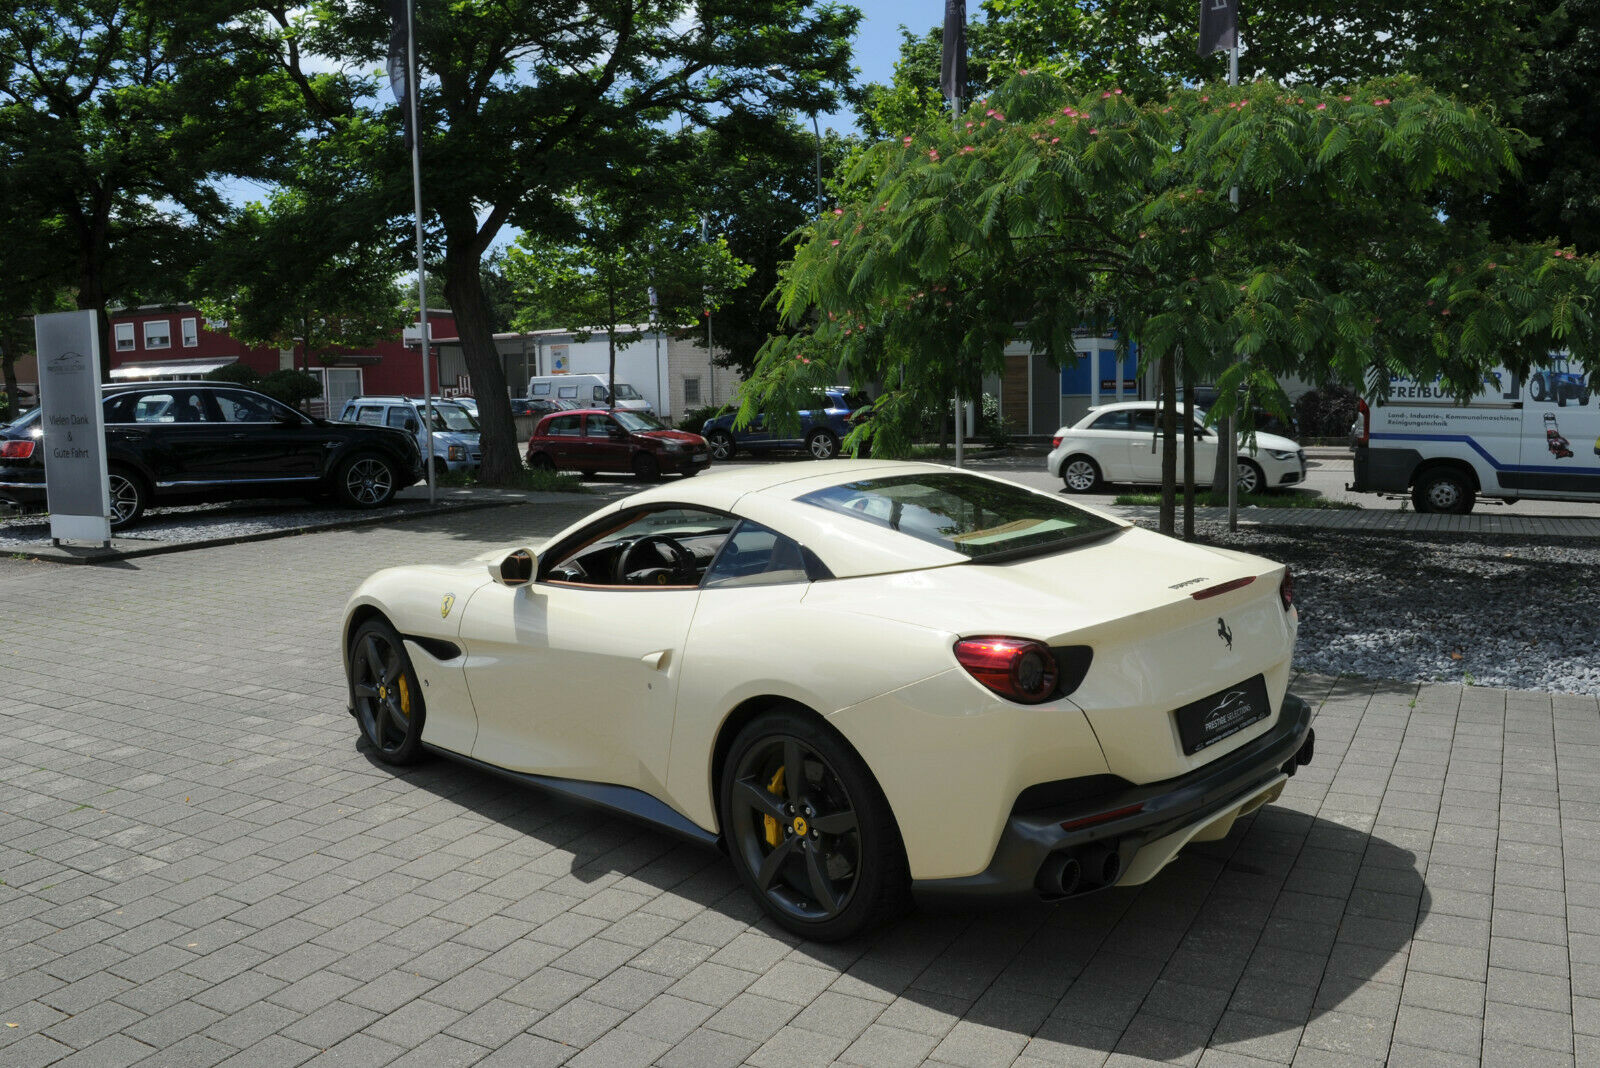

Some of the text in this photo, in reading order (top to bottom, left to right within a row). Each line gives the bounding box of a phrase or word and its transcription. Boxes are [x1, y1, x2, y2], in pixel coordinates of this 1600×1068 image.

[1388, 386, 1456, 399] FREIBUR
[49, 414, 89, 426] Vielen Dank
[67, 431, 73, 442] &
[53, 448, 89, 458] Gute Fahrt
[1205, 714, 1228, 731] PRESTIGE
[1226, 703, 1252, 722] SELECTIONS
